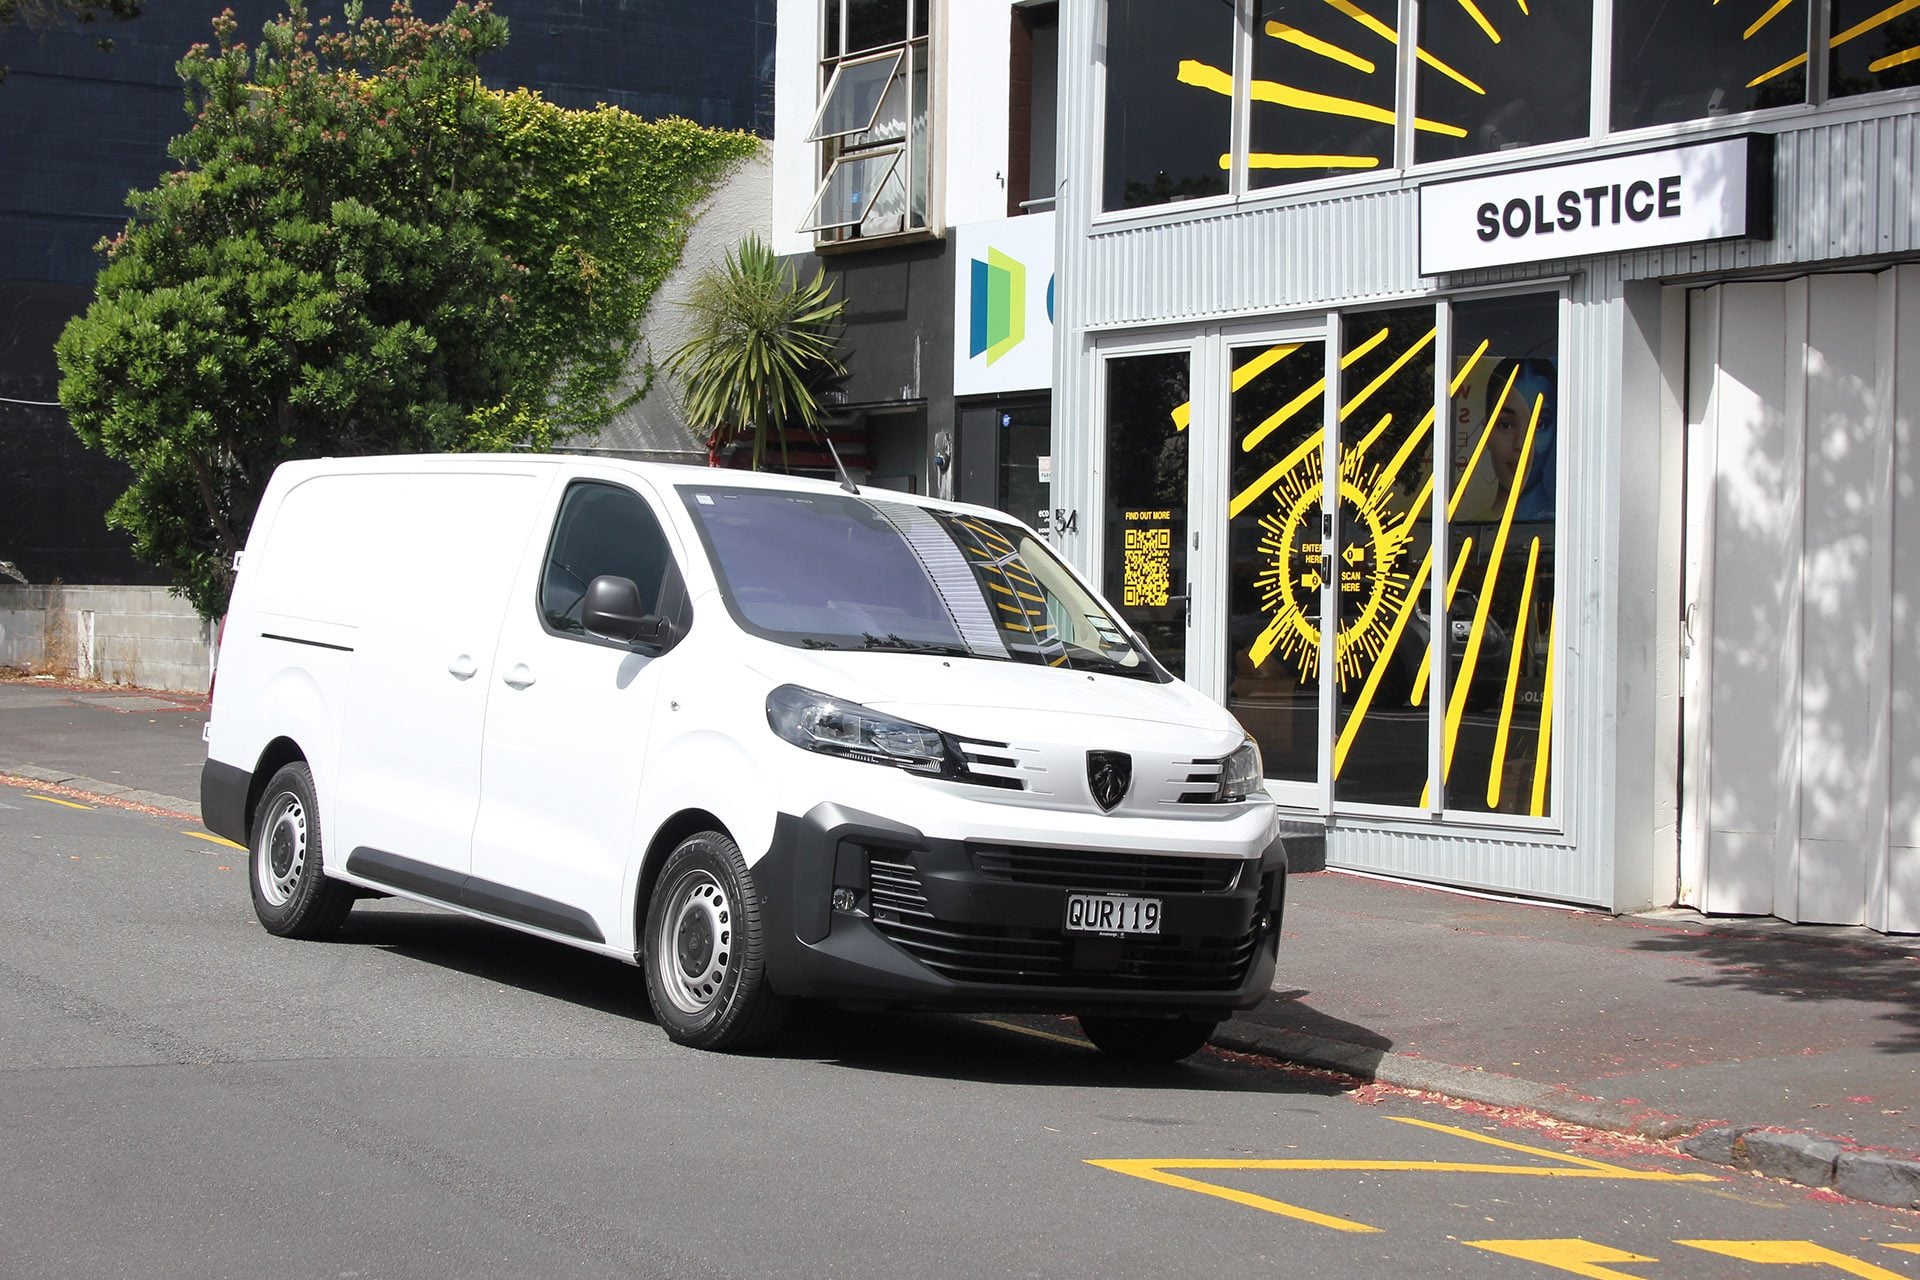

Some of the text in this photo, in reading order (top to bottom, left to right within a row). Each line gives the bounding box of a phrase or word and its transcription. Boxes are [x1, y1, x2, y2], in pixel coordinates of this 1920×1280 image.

[1476, 175, 1682, 242] SOLSTICE
[1125, 511, 1171, 520] FIND OUT MORE
[1055, 509, 1078, 533] 54
[1305, 554, 1322, 564] HERE
[1341, 571, 1360, 580] SCAN
[1341, 583, 1360, 592] HERE
[1069, 899, 1158, 930] QUR119
